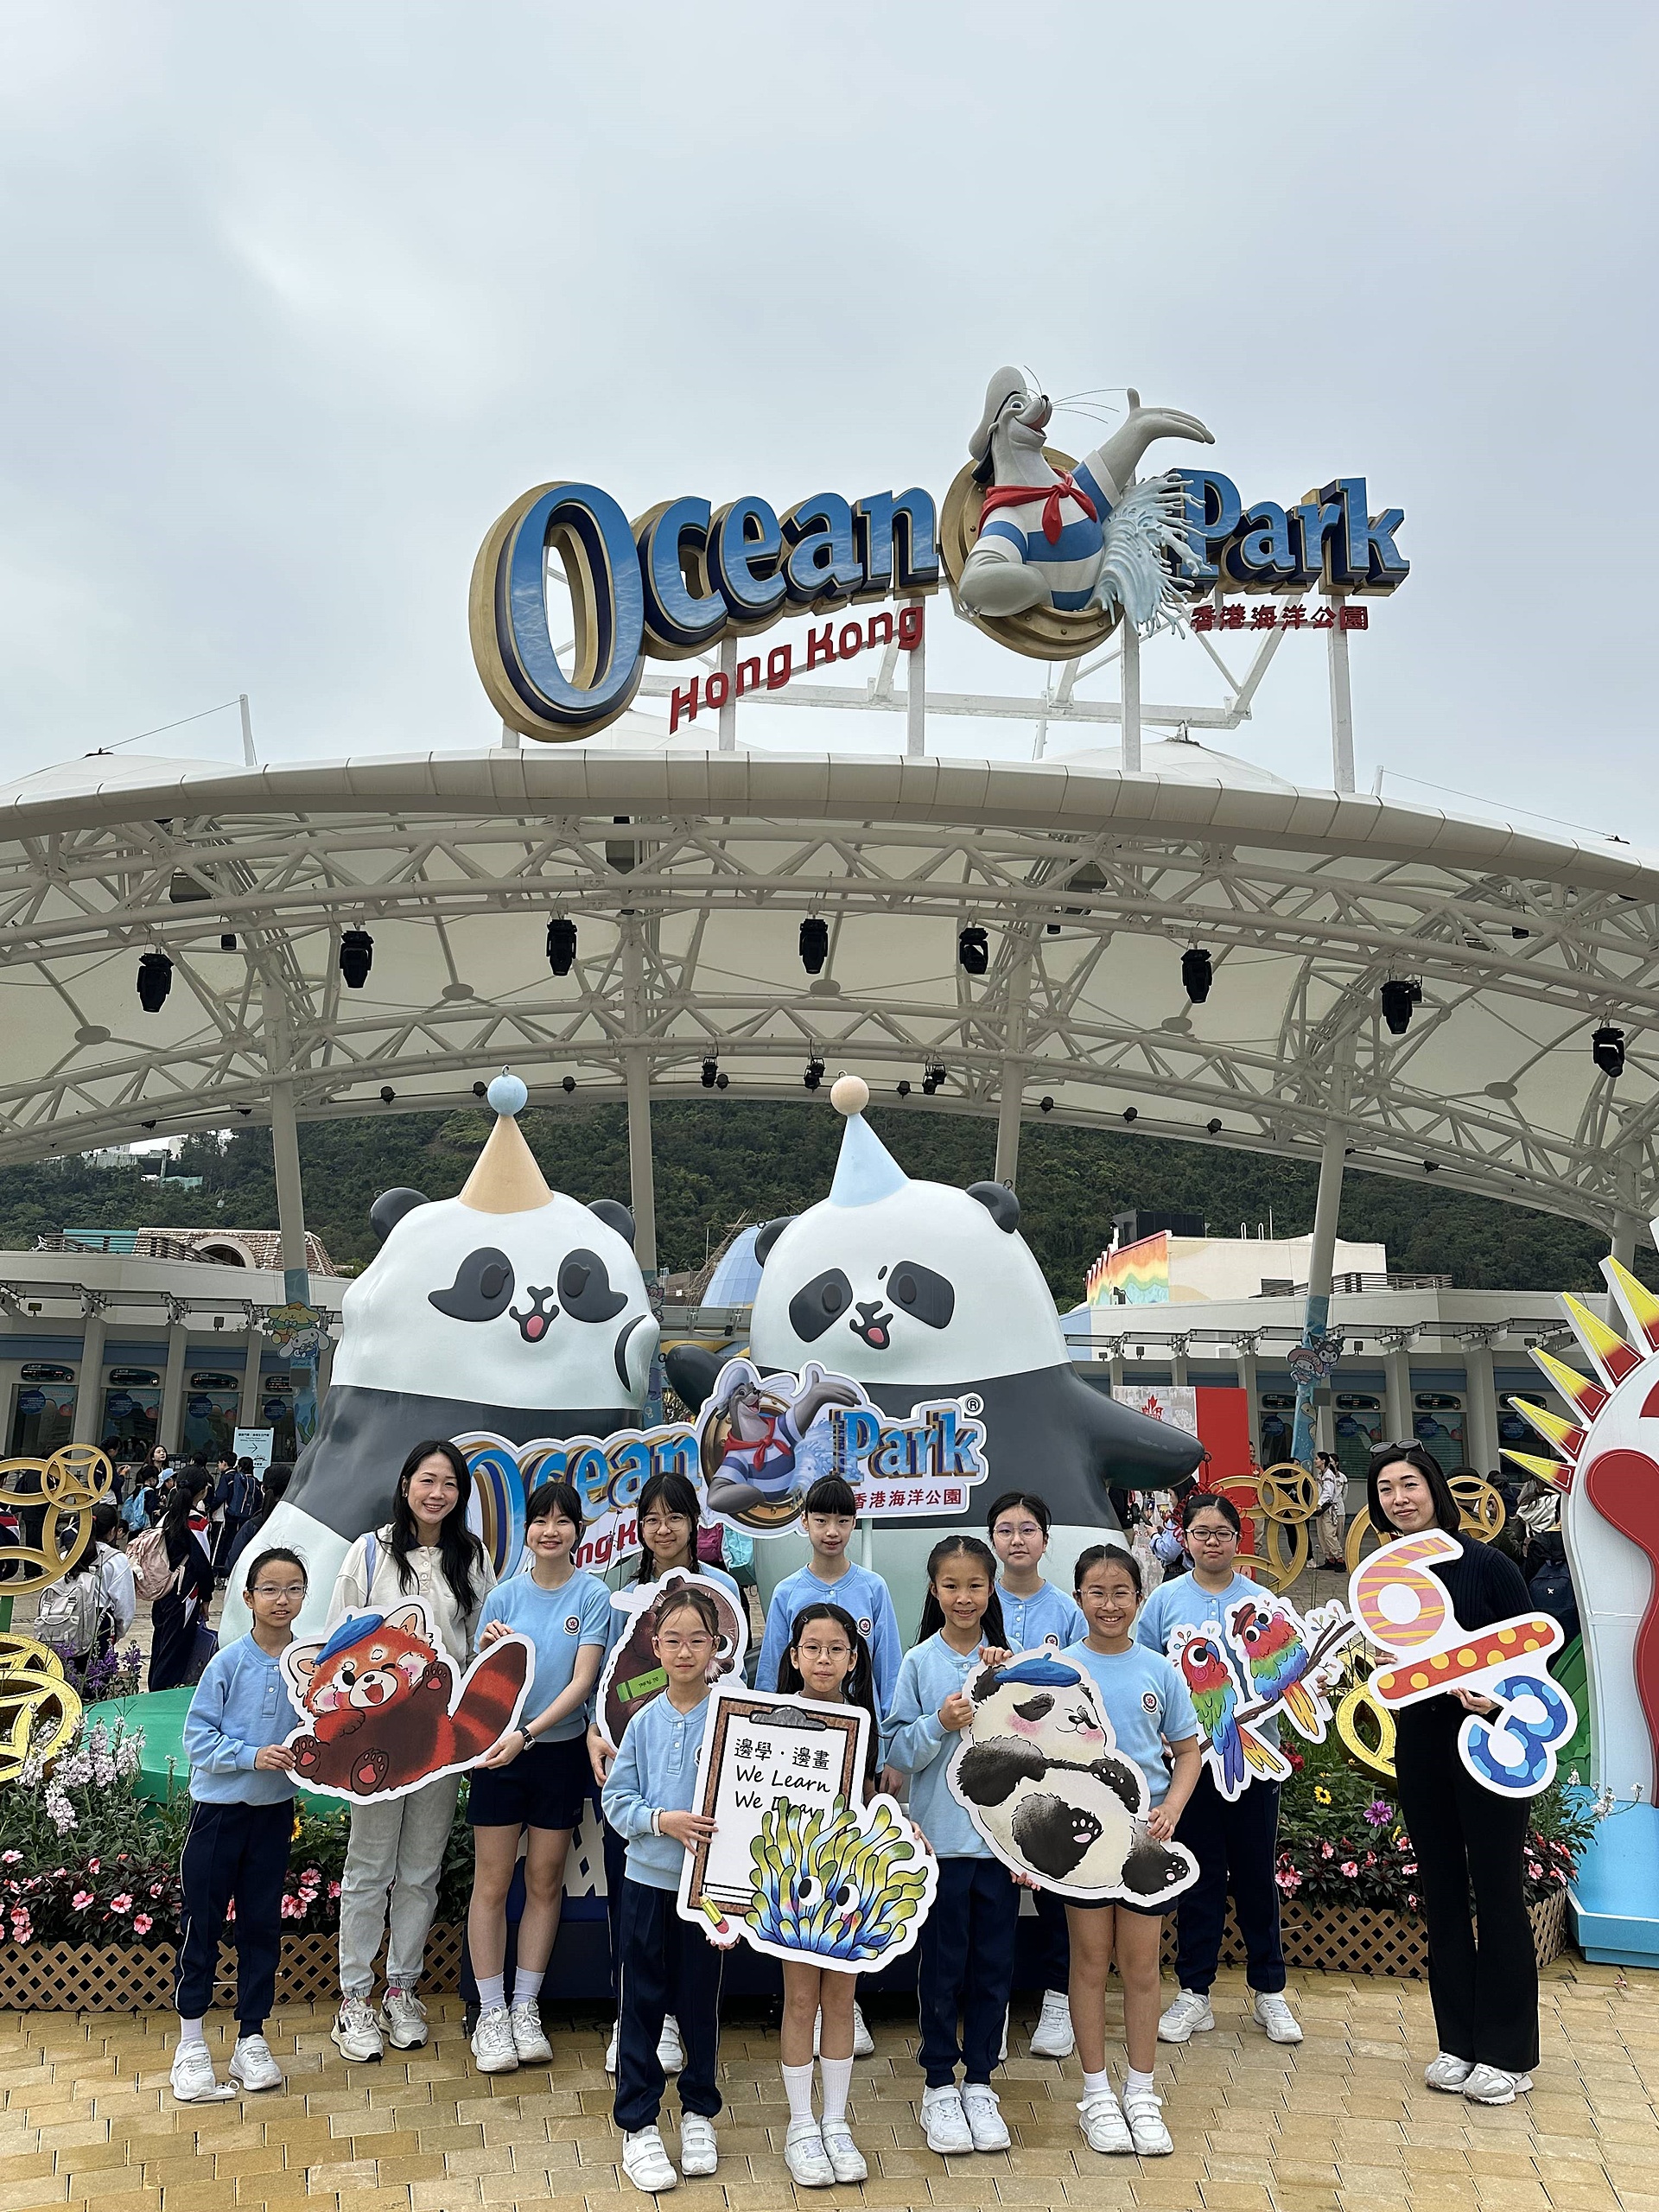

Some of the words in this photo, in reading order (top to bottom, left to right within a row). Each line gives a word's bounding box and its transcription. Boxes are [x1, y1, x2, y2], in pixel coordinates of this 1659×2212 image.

[477, 480, 940, 736] Ocean
[1171, 467, 1410, 594] Park
[1191, 603, 1369, 632] 香港海洋公園
[669, 643, 792, 735] Hong
[806, 605, 925, 672] Kong
[834, 1408, 980, 1485] Park
[854, 1489, 962, 1510] 香港海洋公園
[736, 1764, 764, 1783] We
[772, 1770, 830, 1793] Learn
[735, 1790, 763, 1809] We
